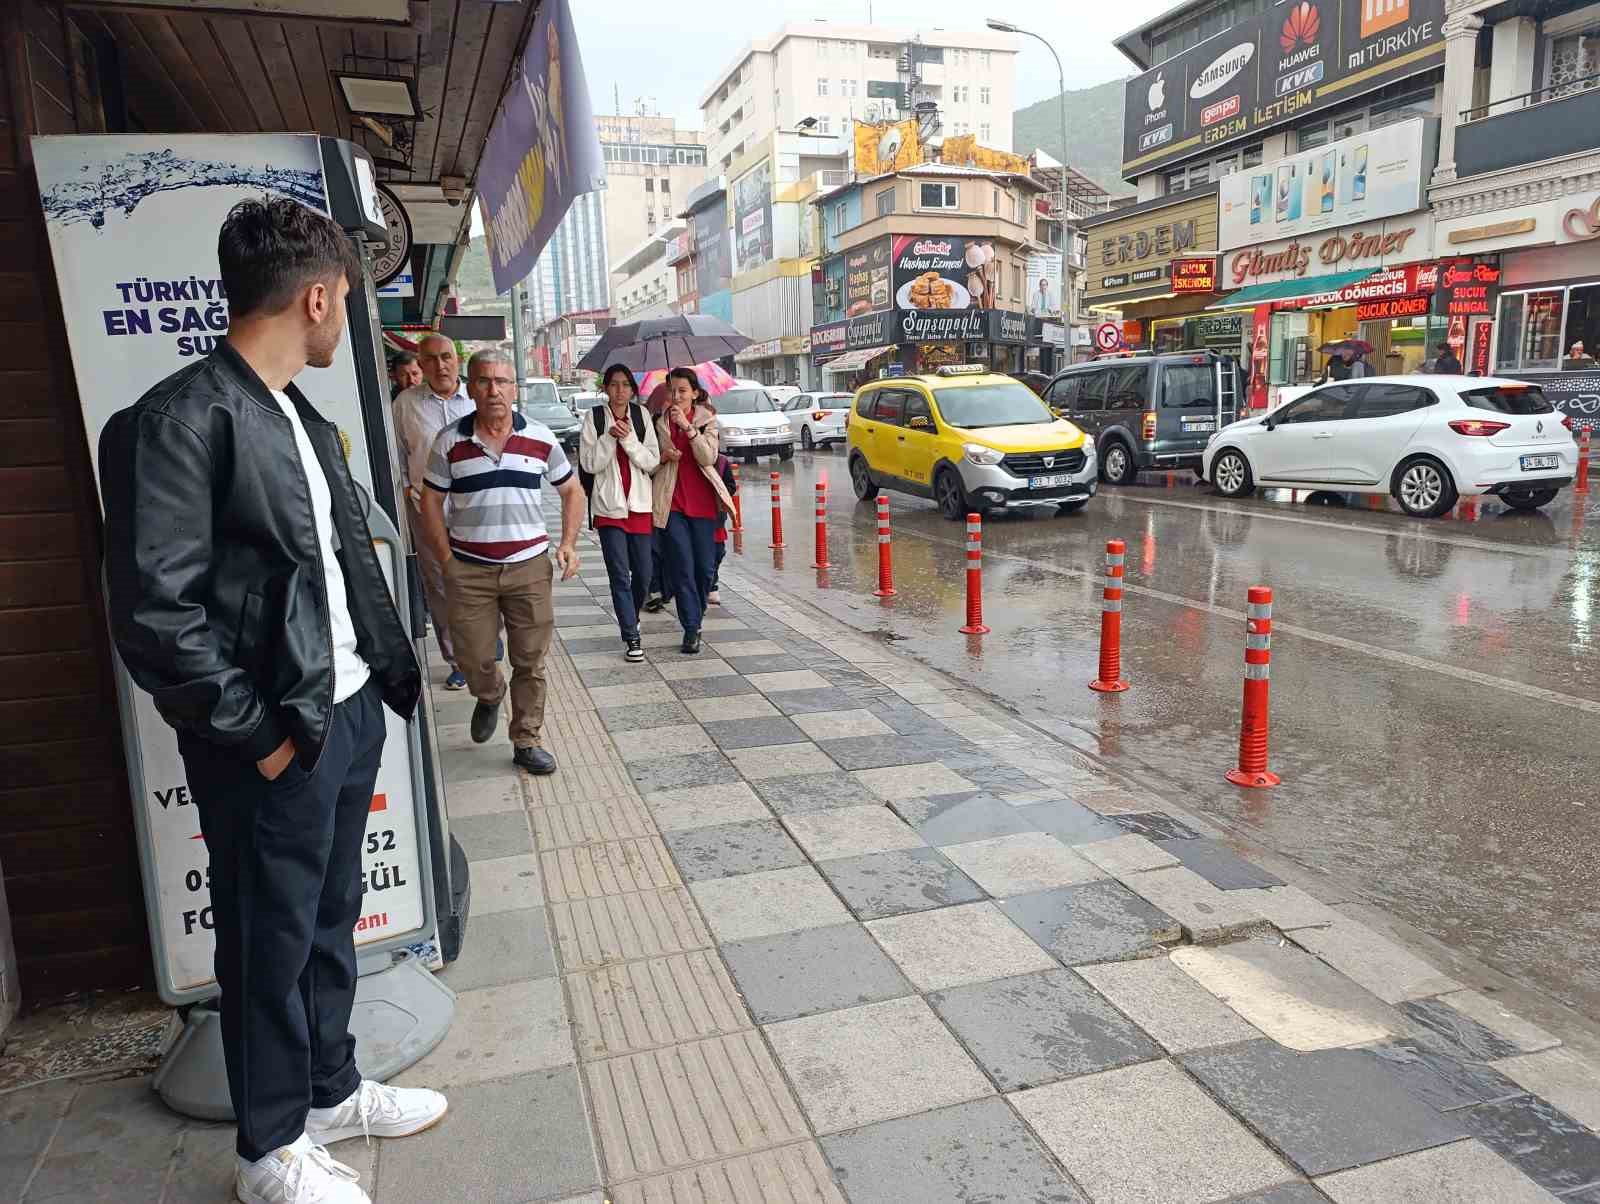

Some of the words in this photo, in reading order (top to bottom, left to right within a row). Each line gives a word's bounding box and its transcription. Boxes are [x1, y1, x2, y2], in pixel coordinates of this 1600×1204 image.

[1368, 21, 1432, 62] TÜRKİYE
[1279, 44, 1320, 71] HUAWEI
[1197, 55, 1247, 88] SAMSUNG
[1281, 66, 1315, 92] KVK
[1145, 110, 1167, 126] iPhone
[1204, 98, 1237, 122] genpa
[1205, 116, 1247, 144] ERDEM
[1253, 88, 1312, 125] İLETİŞİM
[1143, 129, 1168, 147] KVK
[1102, 220, 1197, 266] ERDEM
[1232, 239, 1313, 284] Gümüş
[1319, 227, 1416, 264] Döner
[1181, 263, 1207, 274] SUCUK
[1344, 278, 1407, 299] DÖNERCİSİ
[1454, 287, 1488, 298] SUCUK
[103, 309, 152, 336] EN
[158, 301, 229, 333] SAĞ
[1358, 303, 1389, 318] SUCUK
[1391, 298, 1426, 314] DÖNER
[352, 912, 388, 932] anı
